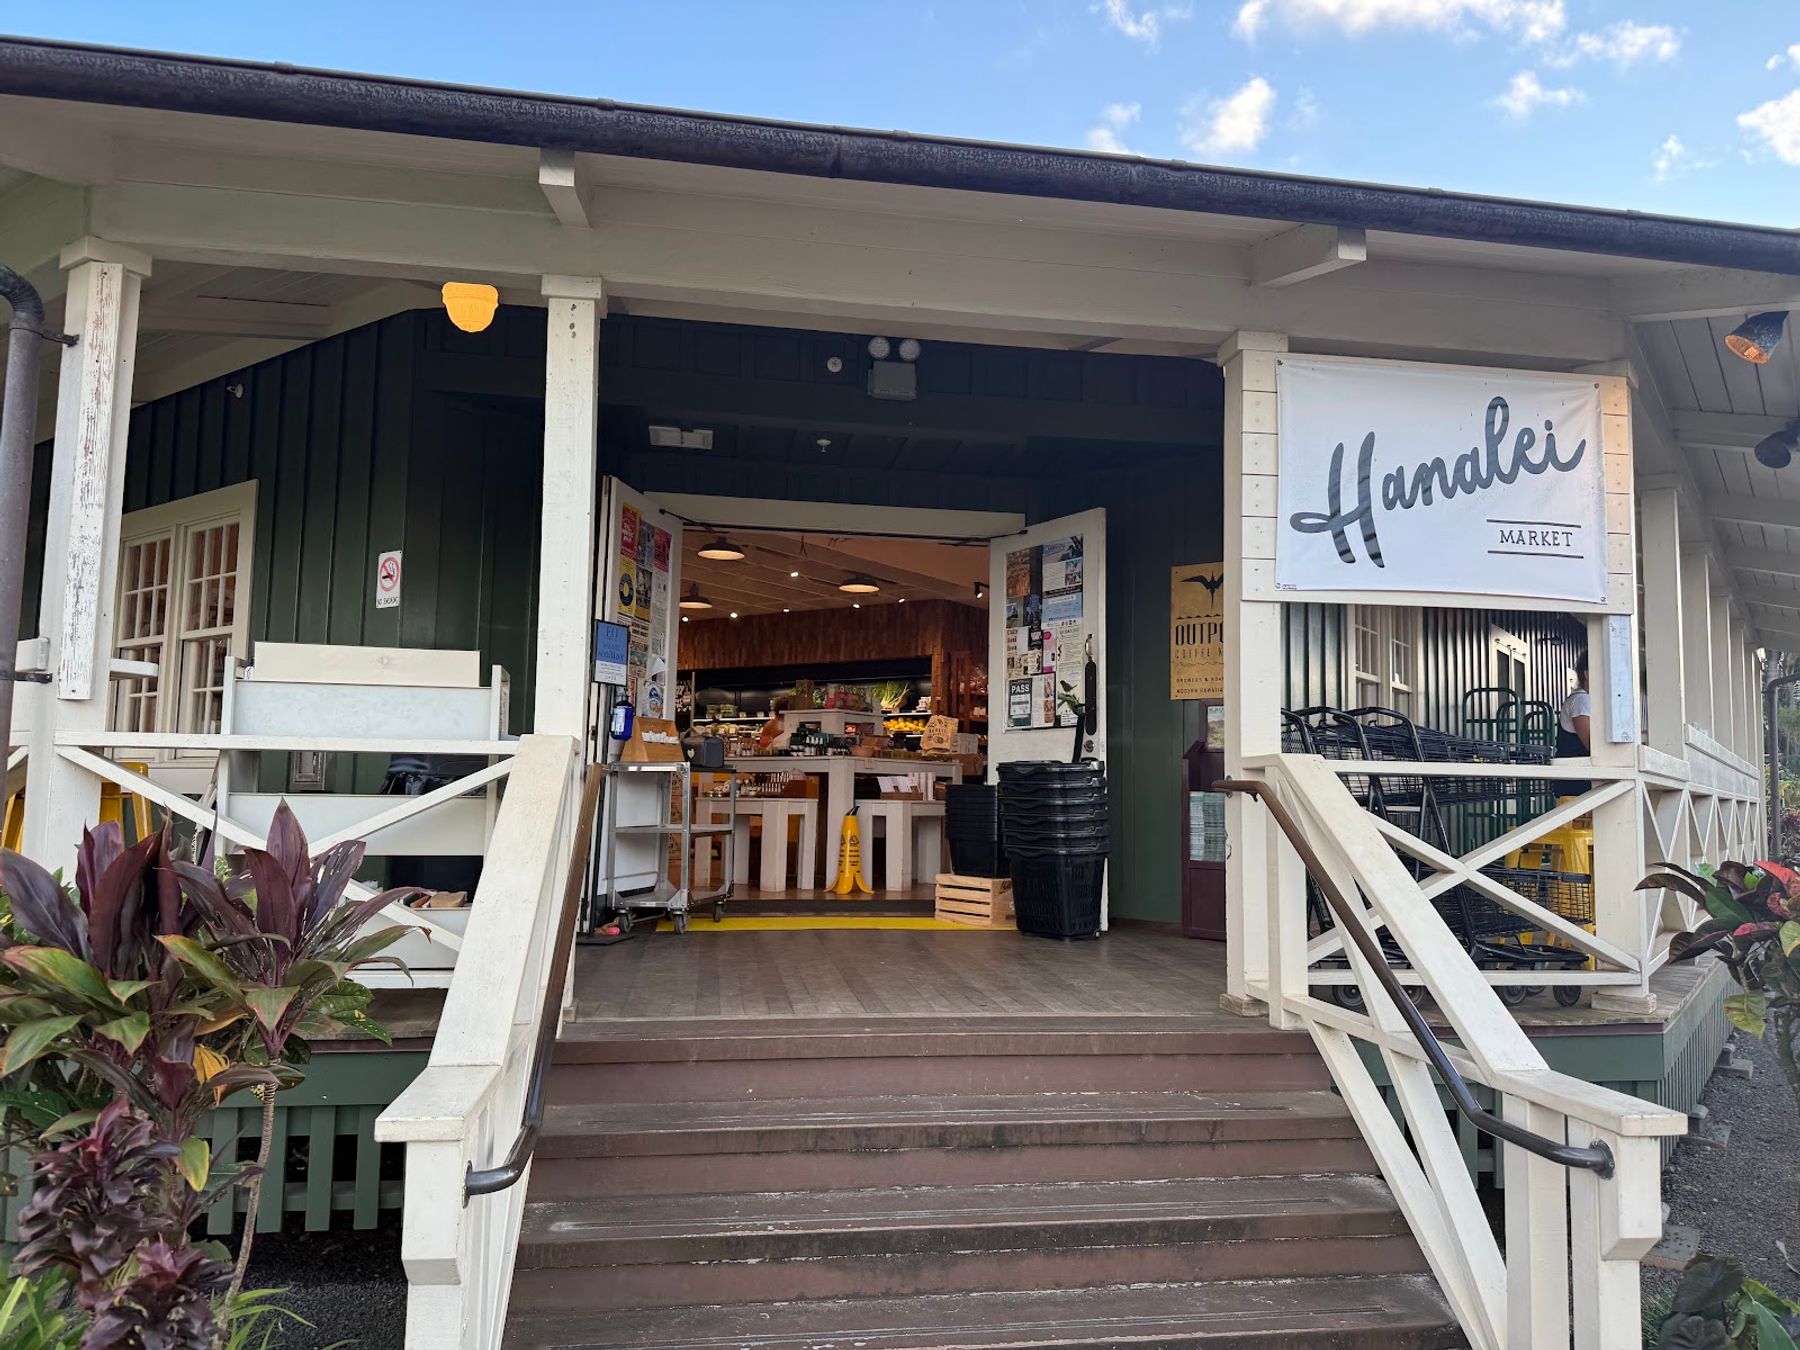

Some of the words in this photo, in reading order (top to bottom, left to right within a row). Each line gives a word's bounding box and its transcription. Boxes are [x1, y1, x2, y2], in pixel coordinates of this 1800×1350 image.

[1289, 396, 1586, 568] Hanalei
[1499, 529, 1574, 547] MARKET
[1011, 684, 1030, 694] PASS
